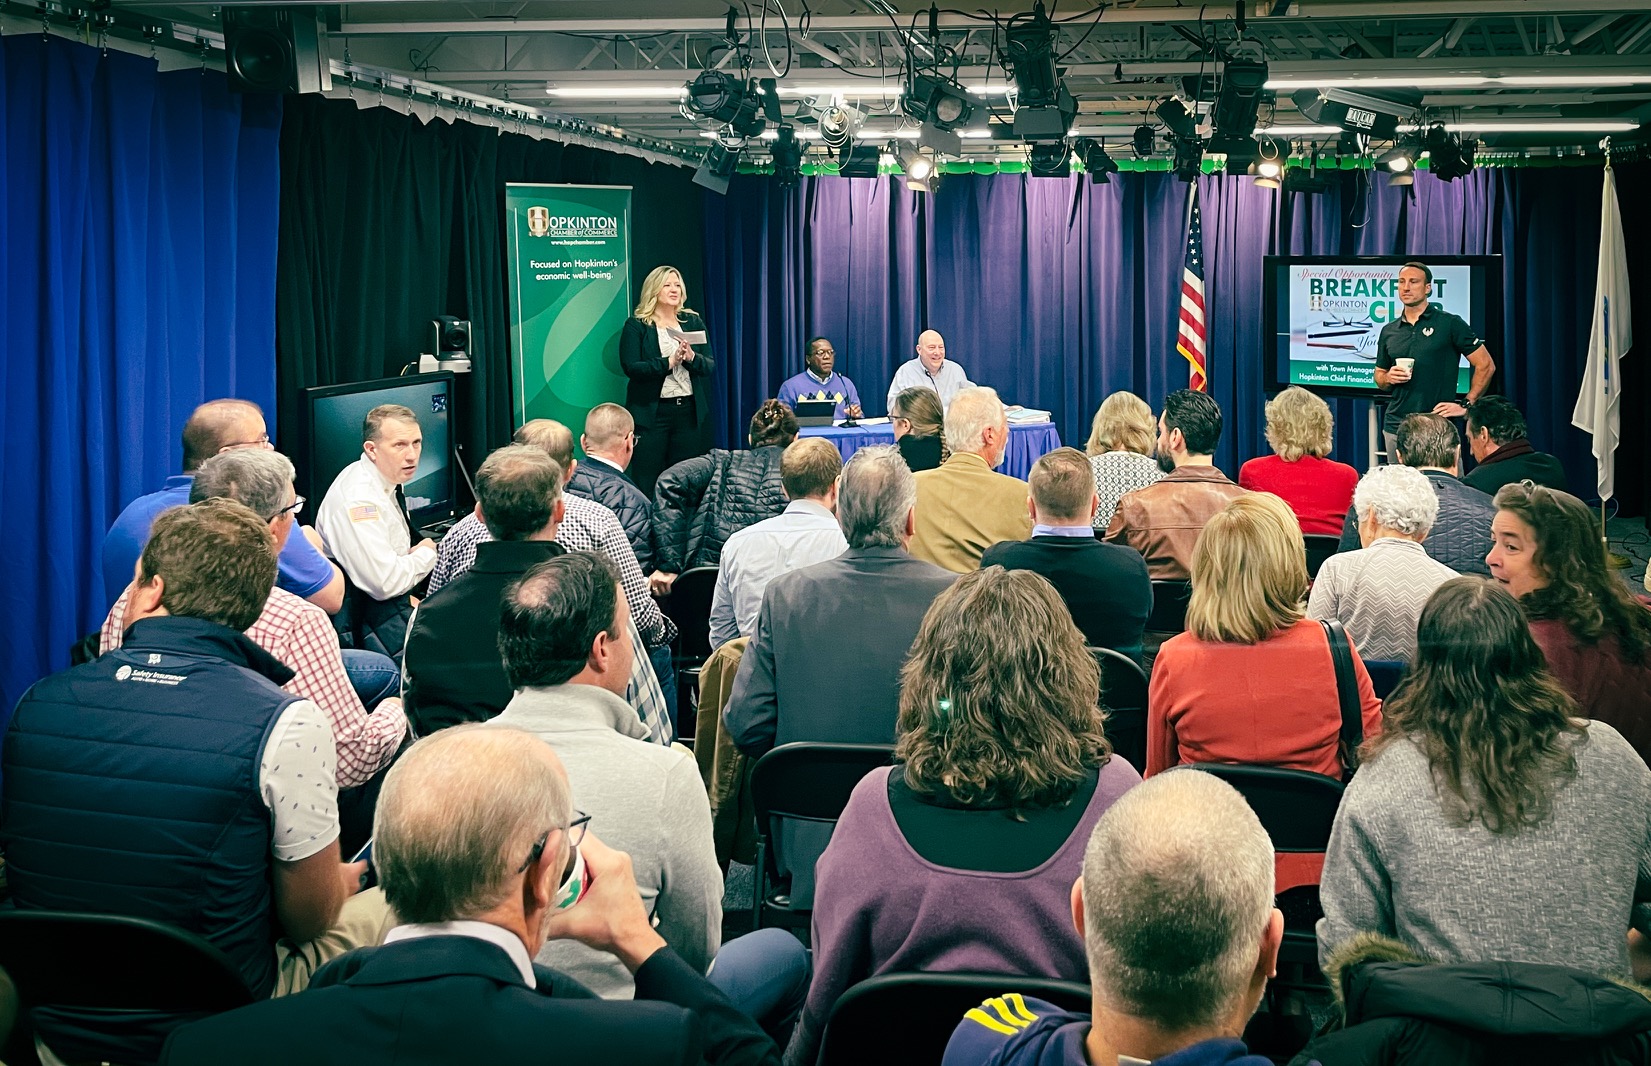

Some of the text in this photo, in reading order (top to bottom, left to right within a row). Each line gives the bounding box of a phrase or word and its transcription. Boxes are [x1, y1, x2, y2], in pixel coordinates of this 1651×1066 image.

[527, 207, 617, 230] HOPKINTON
[530, 260, 560, 269] Focused
[574, 259, 618, 269] Hopkinton's
[535, 271, 614, 280] economic well-being.
[1298, 268, 1394, 282] Special Opportunity
[1310, 279, 1447, 298] BREAKFT
[1316, 364, 1329, 372] with
[1299, 373, 1374, 384] Hopkinton Chief Financial
[131, 670, 153, 679] Safety
